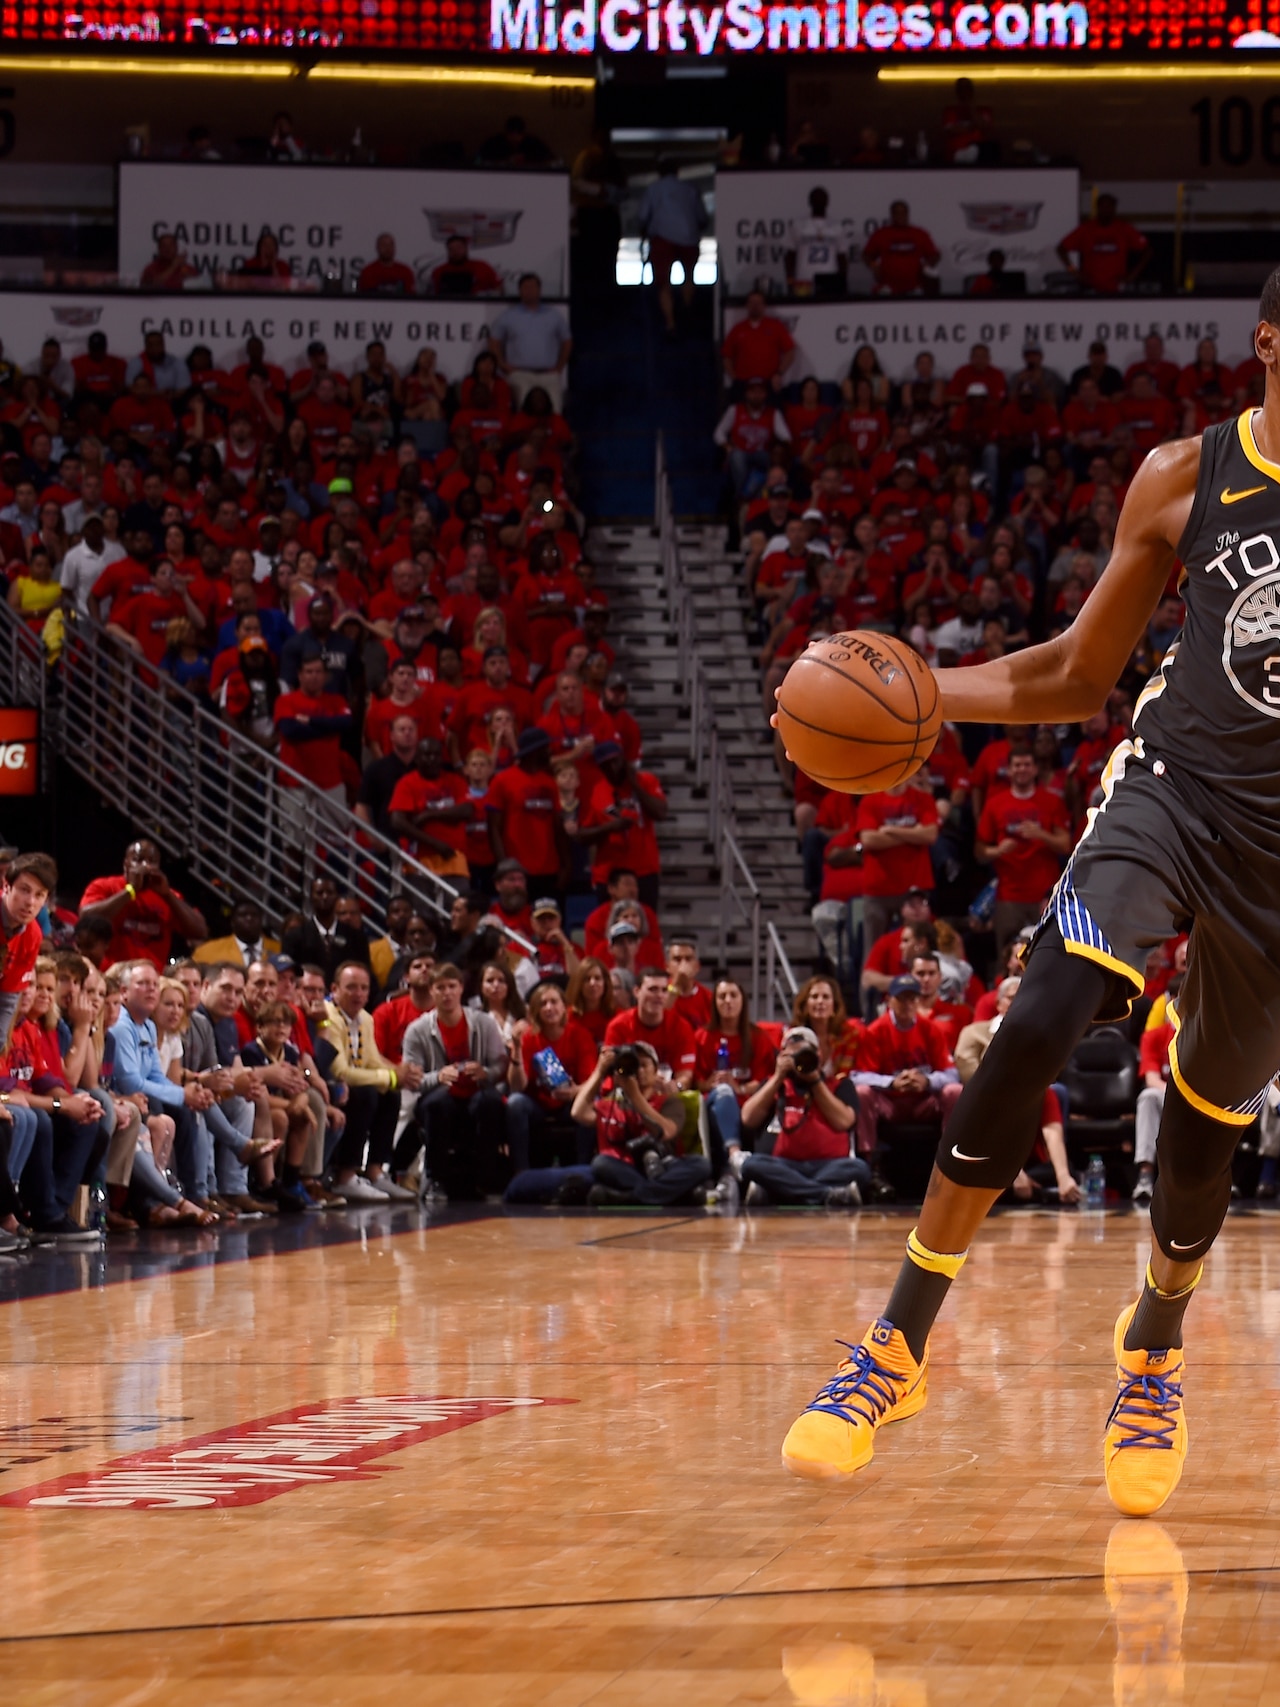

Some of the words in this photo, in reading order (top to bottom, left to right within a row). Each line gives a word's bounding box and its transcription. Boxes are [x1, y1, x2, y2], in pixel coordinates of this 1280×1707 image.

[488, 0, 1089, 54] MidCitySmiles.com
[306, 225, 342, 247] OF
[141, 317, 275, 339] CADILLAC
[289, 320, 319, 339] OF
[334, 321, 394, 340] NEW
[835, 323, 967, 344] CADILLAC
[980, 324, 1013, 343] OF
[1024, 323, 1083, 342] NEW
[1096, 321, 1219, 342] ORLEANS
[1215, 530, 1240, 552] The
